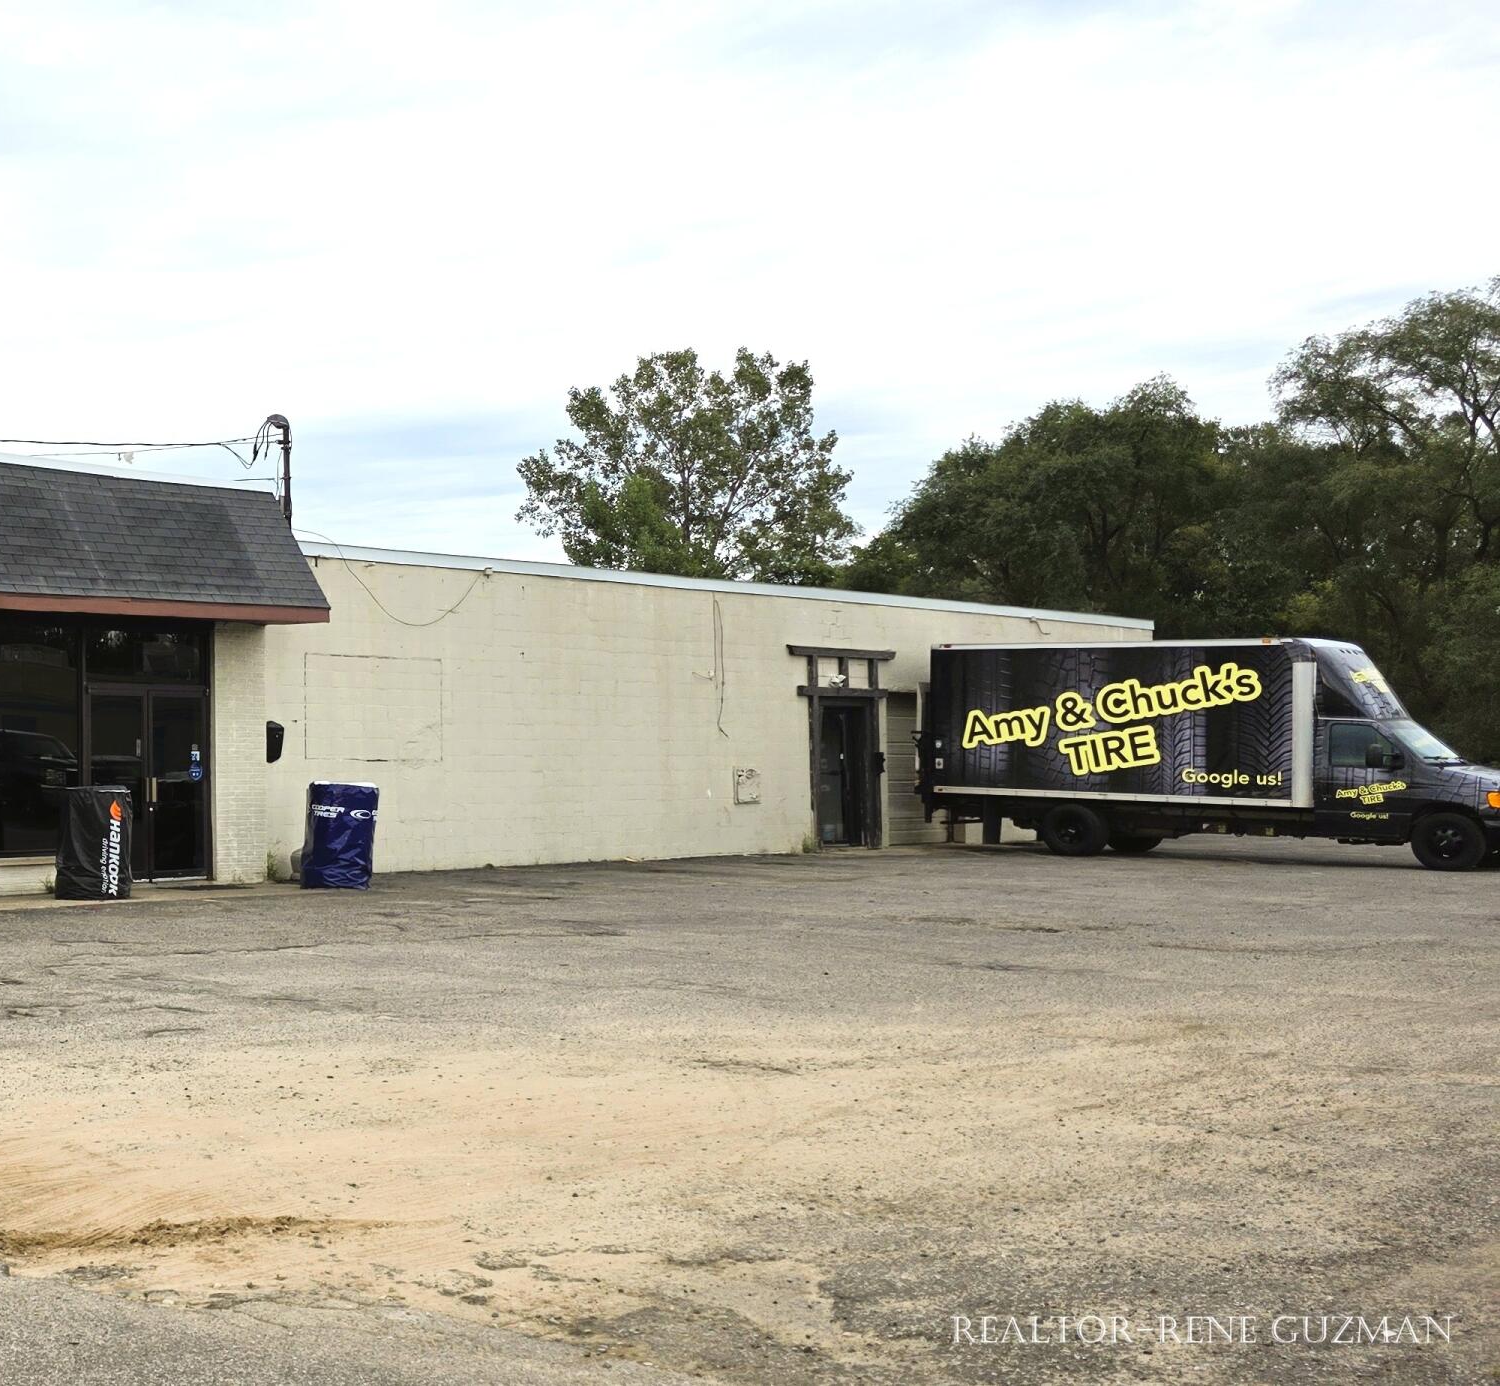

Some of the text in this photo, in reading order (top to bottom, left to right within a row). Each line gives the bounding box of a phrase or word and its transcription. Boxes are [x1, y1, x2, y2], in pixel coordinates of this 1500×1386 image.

[963, 662, 1263, 750] Amy & Chuck's
[1060, 725, 1160, 776] TIRE
[1181, 768, 1283, 788] Google us!
[1336, 781, 1406, 798] Amy & Chuck's
[1360, 794, 1384, 804] TIRE
[312, 805, 345, 813] COOPER
[1350, 811, 1377, 820] Google
[100, 838, 108, 865] driving
